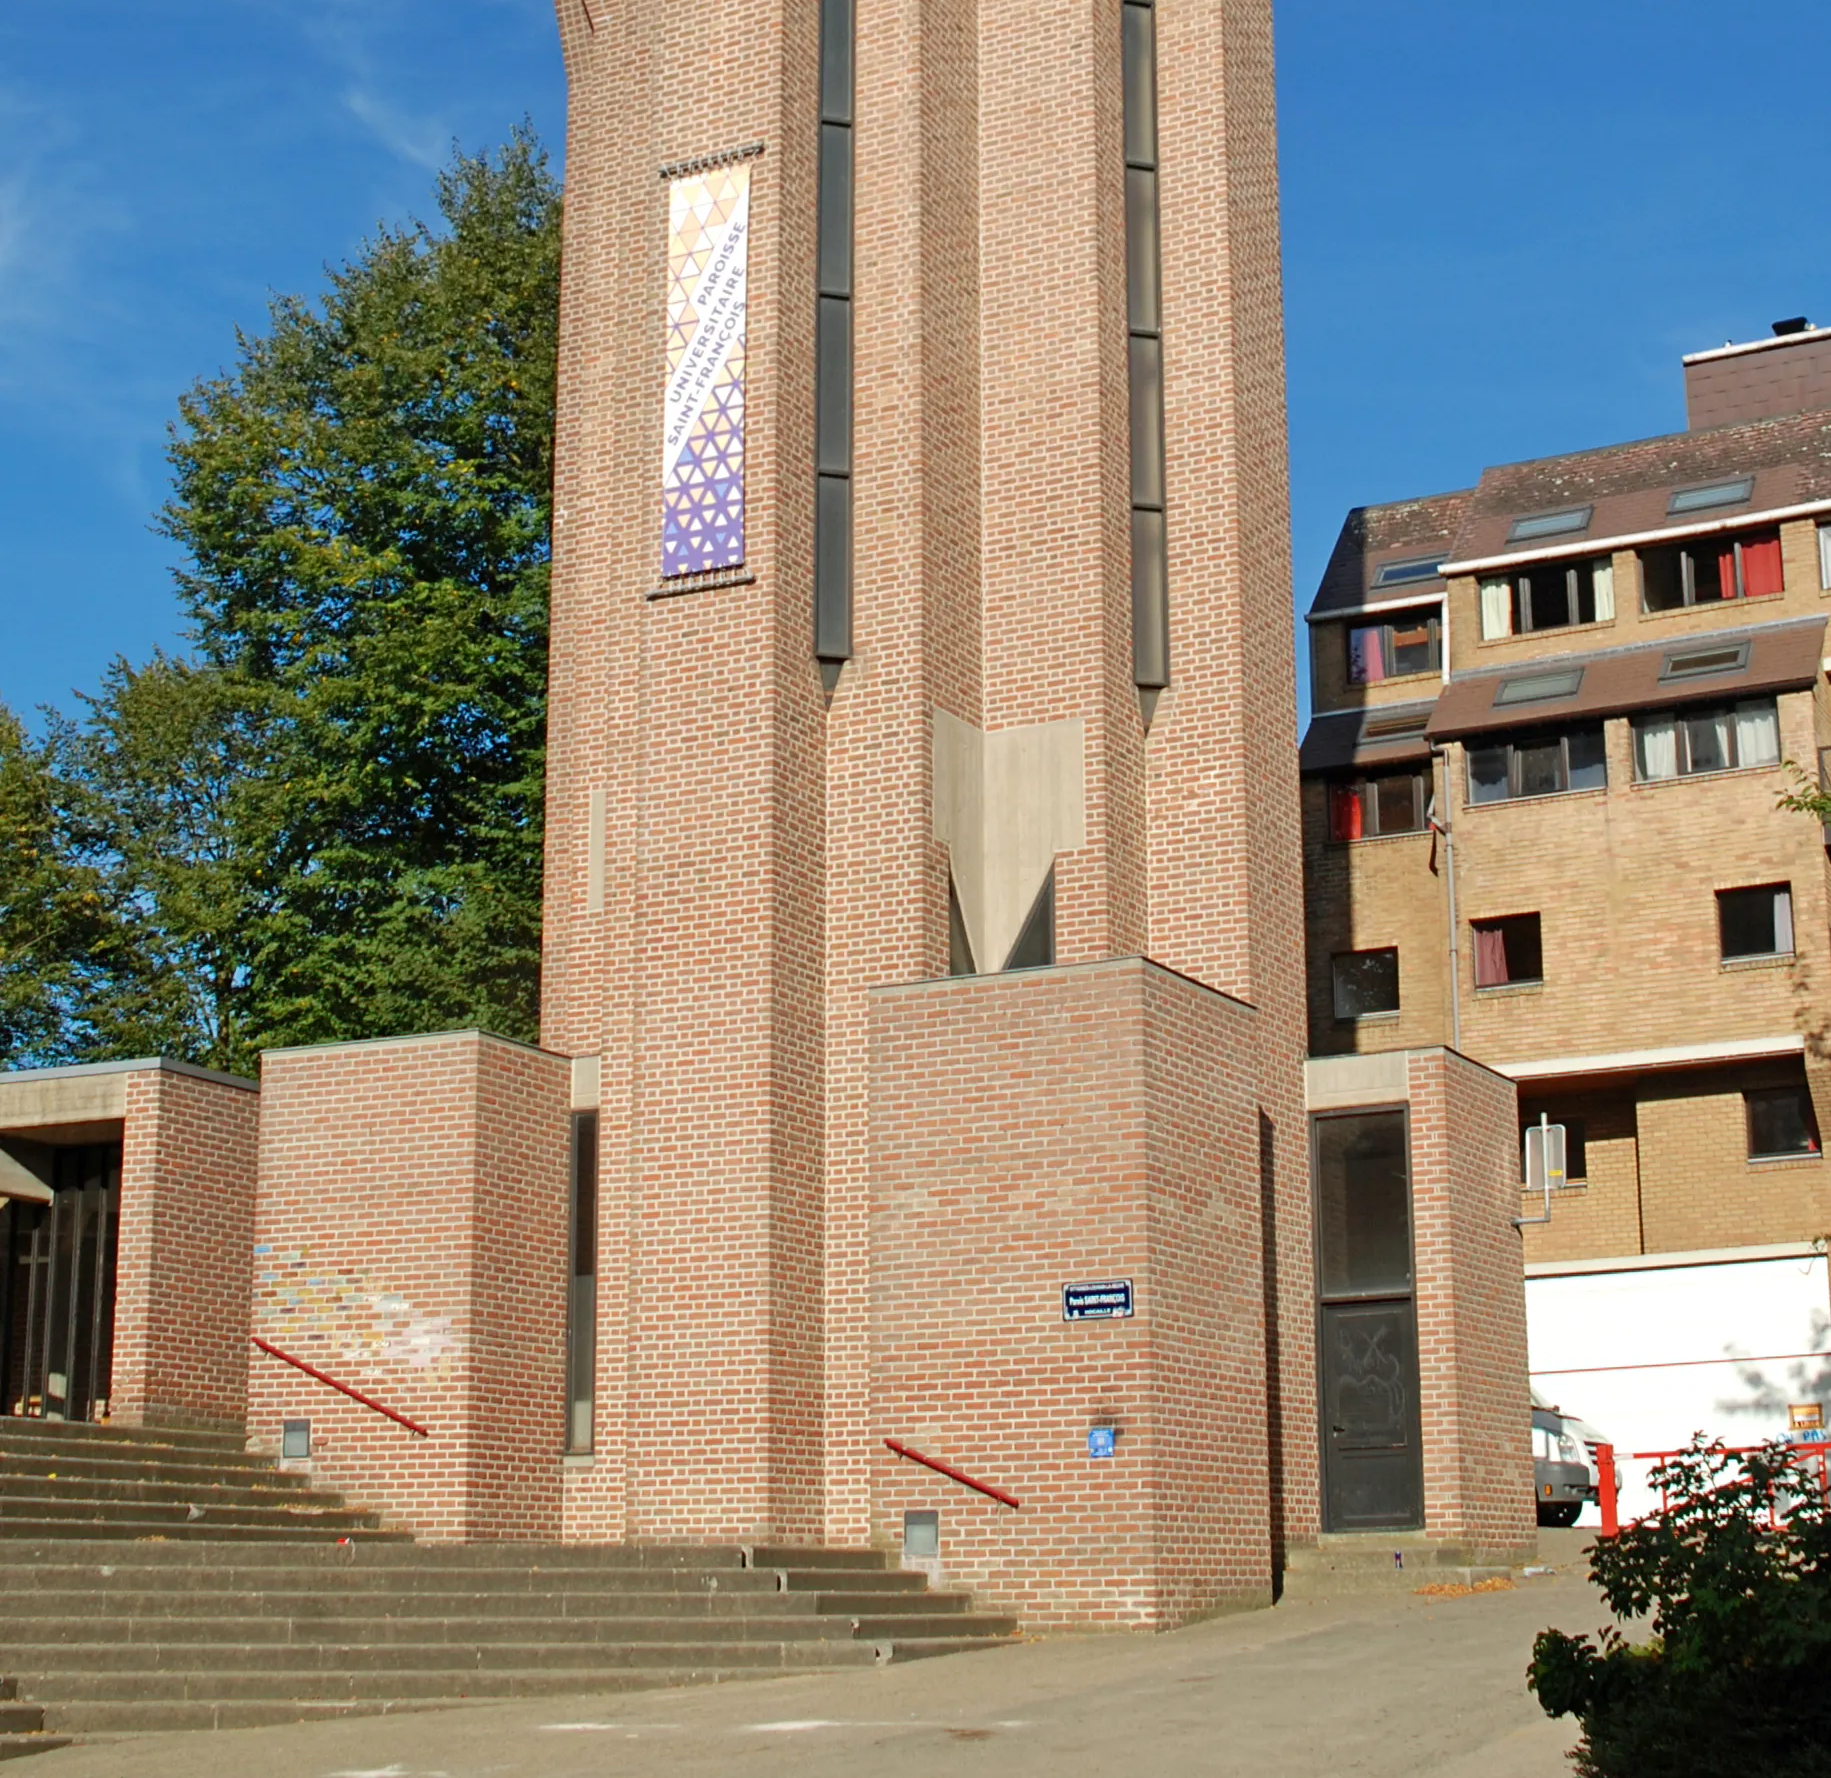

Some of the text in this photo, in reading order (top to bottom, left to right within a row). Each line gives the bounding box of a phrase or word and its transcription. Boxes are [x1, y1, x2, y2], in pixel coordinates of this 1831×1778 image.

[697, 221, 746, 306] PAROISSE
[667, 300, 746, 446] SAINT-FRANÇOIS
[669, 265, 745, 404] UNIVERSITAIRE
